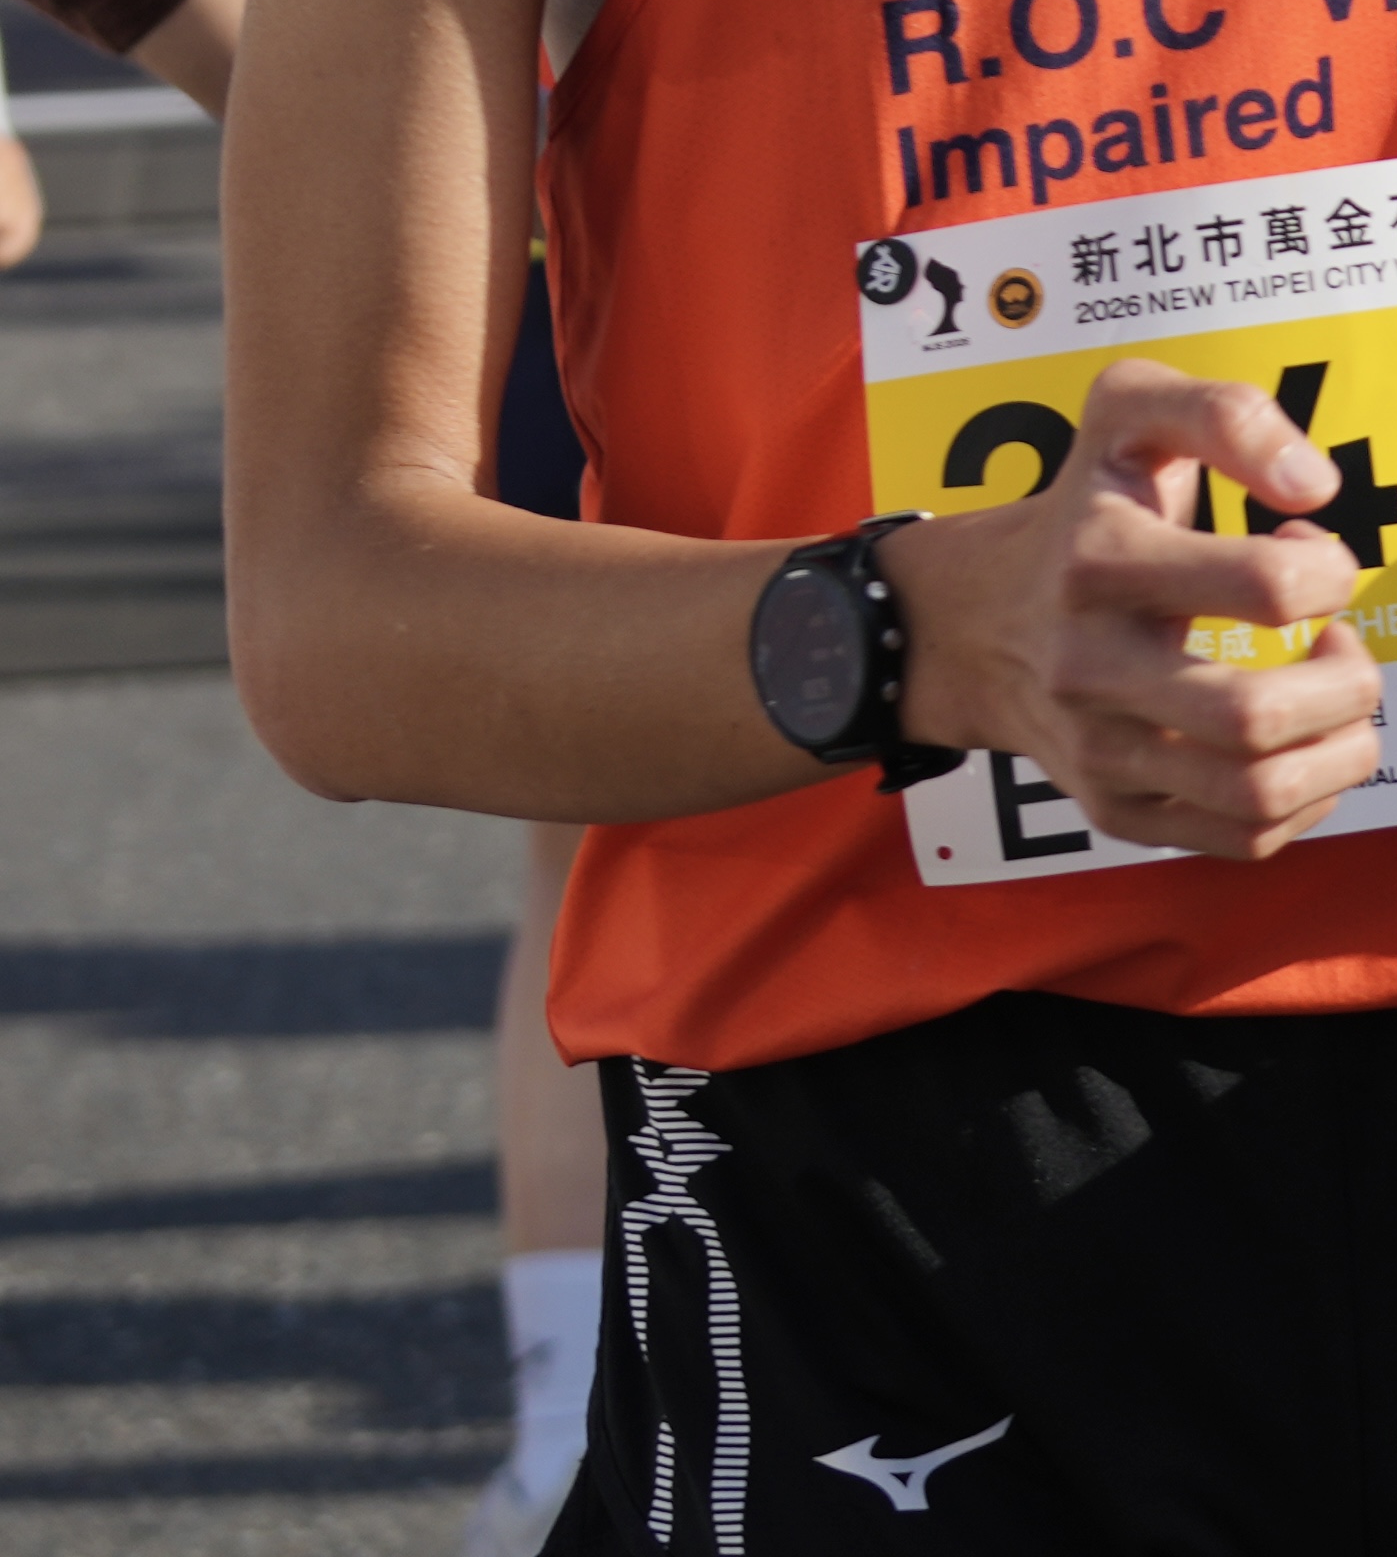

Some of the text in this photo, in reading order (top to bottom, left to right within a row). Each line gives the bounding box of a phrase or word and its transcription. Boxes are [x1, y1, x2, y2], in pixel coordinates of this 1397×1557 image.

[898, 56, 1336, 207] Impaired
[1075, 294, 1142, 325] 2026
[1148, 283, 1215, 315] NEW
[1224, 272, 1317, 304] TAIPEI
[1324, 259, 1389, 290] CITY
[988, 747, 1093, 861] E
